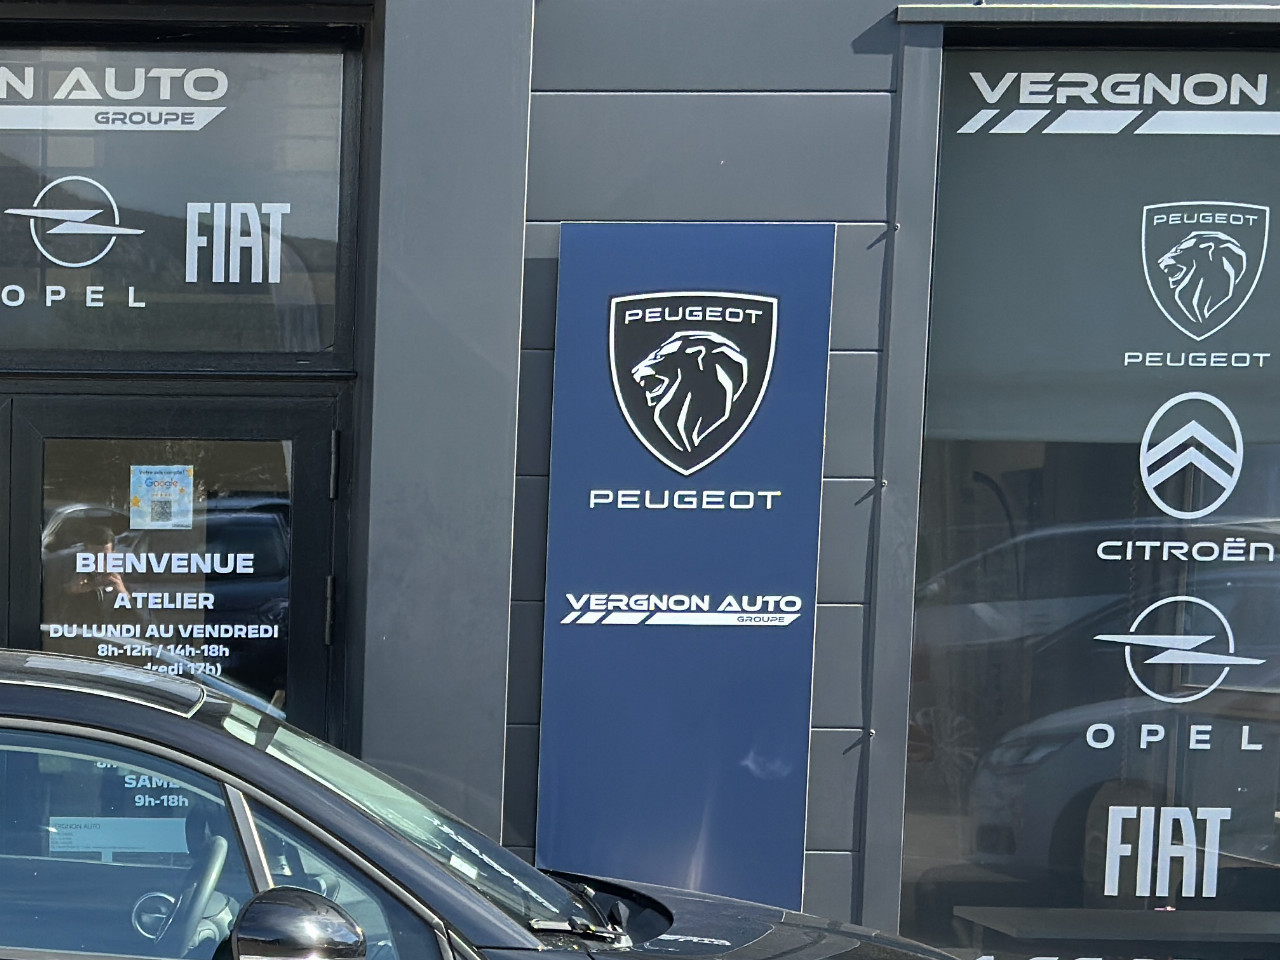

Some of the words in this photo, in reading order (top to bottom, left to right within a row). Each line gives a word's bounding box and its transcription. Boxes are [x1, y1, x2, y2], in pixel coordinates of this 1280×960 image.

[53, 67, 228, 100] AUTO
[970, 73, 1267, 105] VERGNON
[95, 112, 194, 125] GROUPE
[1154, 213, 1257, 225] PEUGEOT
[186, 202, 290, 283] FIAT
[2, 285, 145, 307] OPEL
[625, 307, 762, 324] PEUGEOT
[1125, 353, 1270, 366] PEUGEOT
[145, 477, 178, 489] Google
[590, 490, 781, 509] PEUGEOT
[75, 552, 255, 574] BIENVENUE
[113, 592, 215, 609] ATELIER
[566, 594, 709, 611] VERGNON
[717, 595, 802, 612] AUTO
[737, 616, 785, 624] GROUPE
[50, 624, 77, 638] DU
[82, 624, 141, 638] LUNDI
[145, 624, 174, 638] AU
[178, 624, 279, 639] VENDREDI
[97, 643, 153, 657] 8h-12h
[167, 643, 230, 657] 14h-18h
[1087, 724, 1262, 750] OPEL
[135, 795, 189, 807] 9h-18h
[1103, 806, 1231, 897] FIAT
